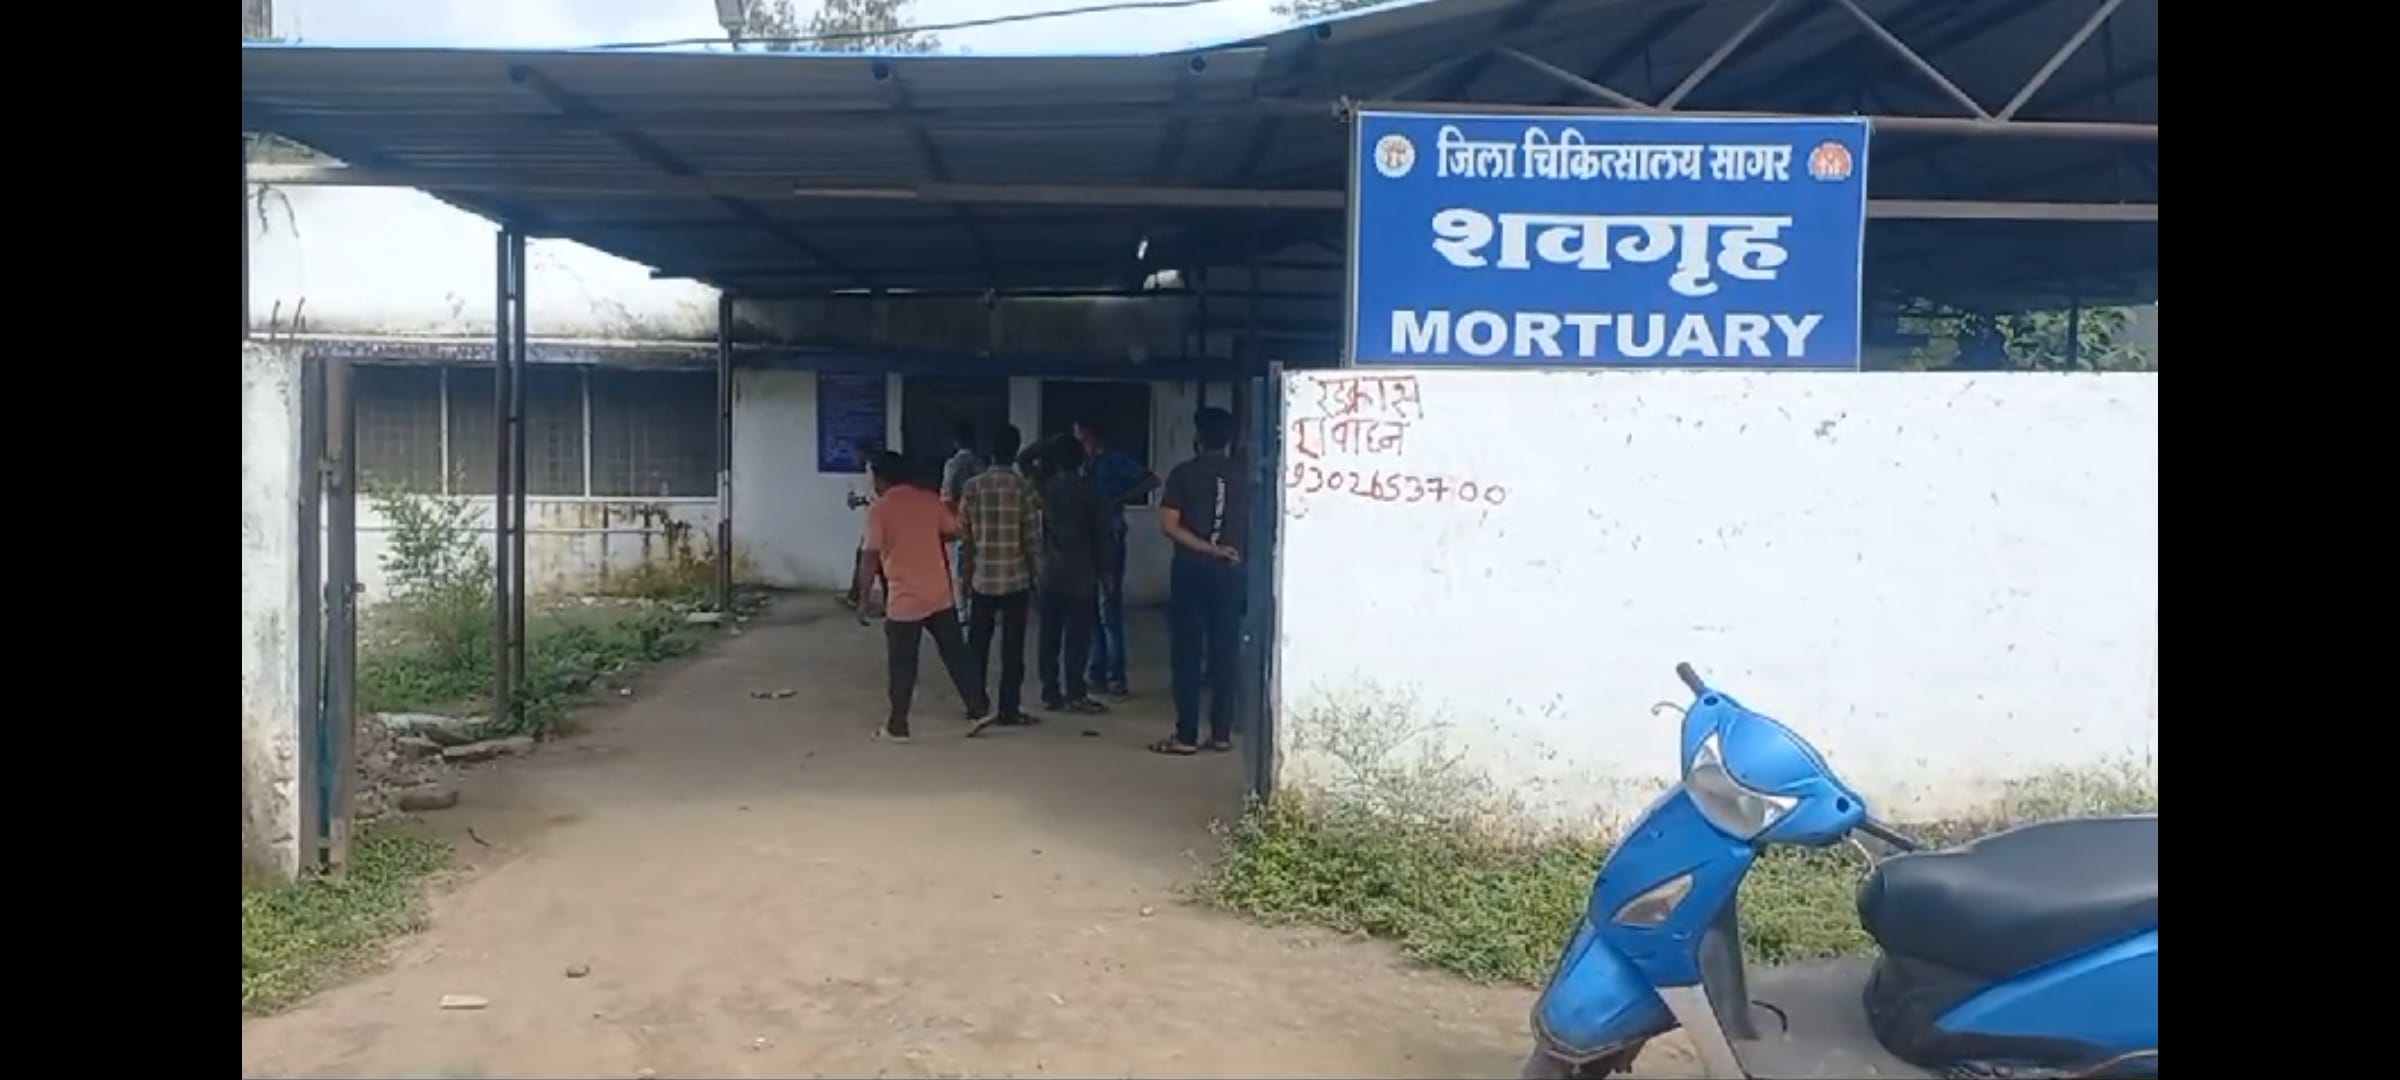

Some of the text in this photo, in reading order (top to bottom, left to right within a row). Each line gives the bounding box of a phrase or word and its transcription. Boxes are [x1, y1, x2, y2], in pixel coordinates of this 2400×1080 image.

[1437, 126, 1792, 180] जिला चिकित्सालय सागर
[1433, 209, 1792, 295] शवगृह
[1392, 311, 1822, 357] MORTUARY
[1285, 461, 1506, 505] 9302653700
